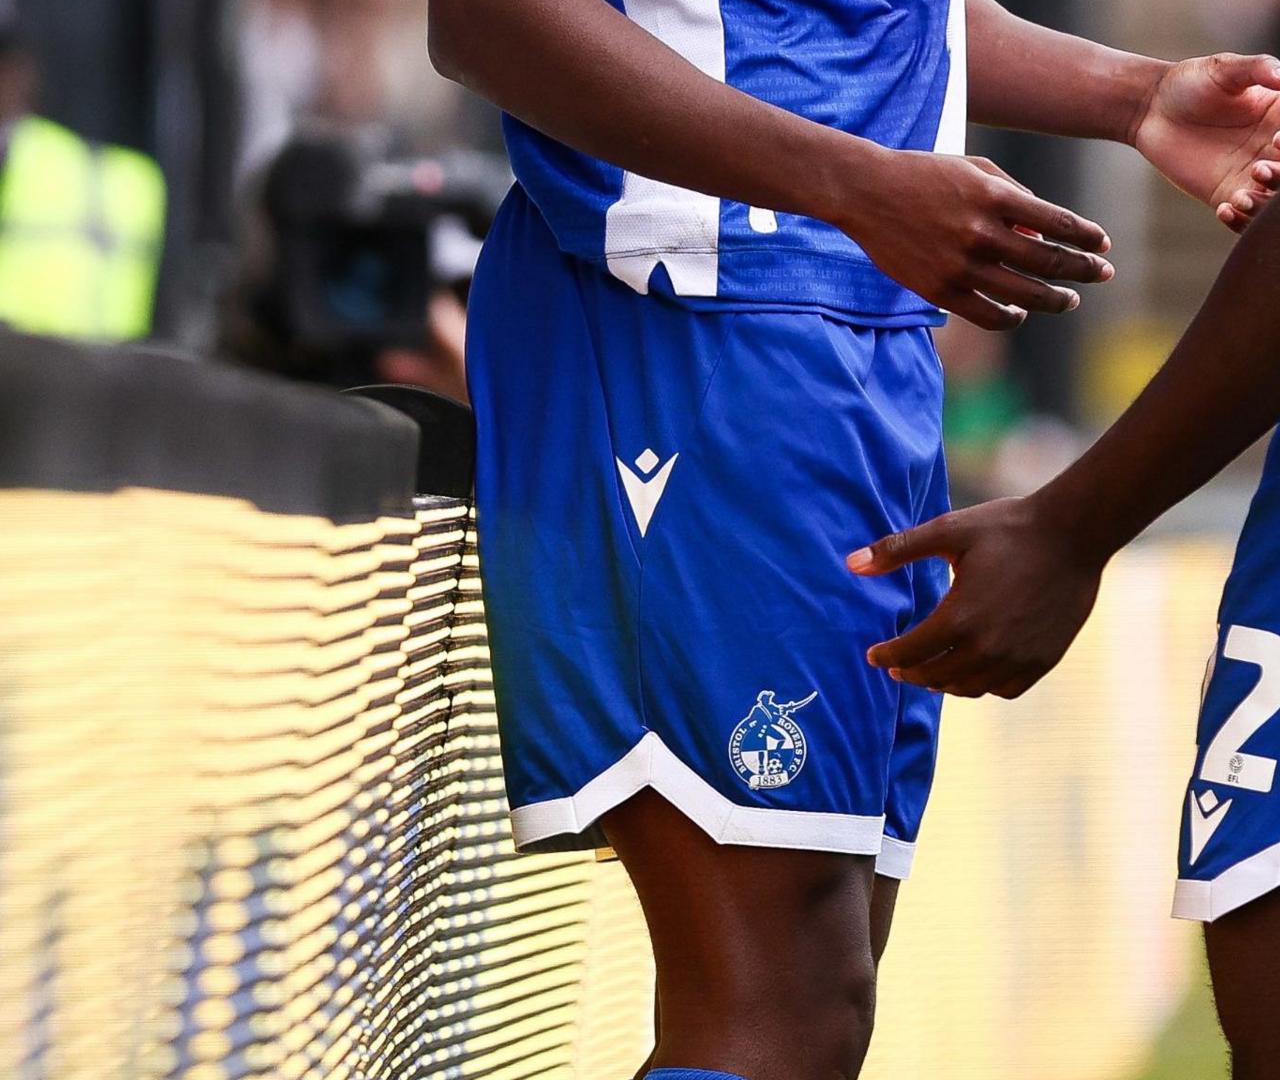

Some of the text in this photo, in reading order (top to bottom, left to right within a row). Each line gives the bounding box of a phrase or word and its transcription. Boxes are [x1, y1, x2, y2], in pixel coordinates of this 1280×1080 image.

[732, 727, 747, 774] BRISTOL
[777, 718, 803, 756] ROVERS
[756, 776, 783, 786] 1883
